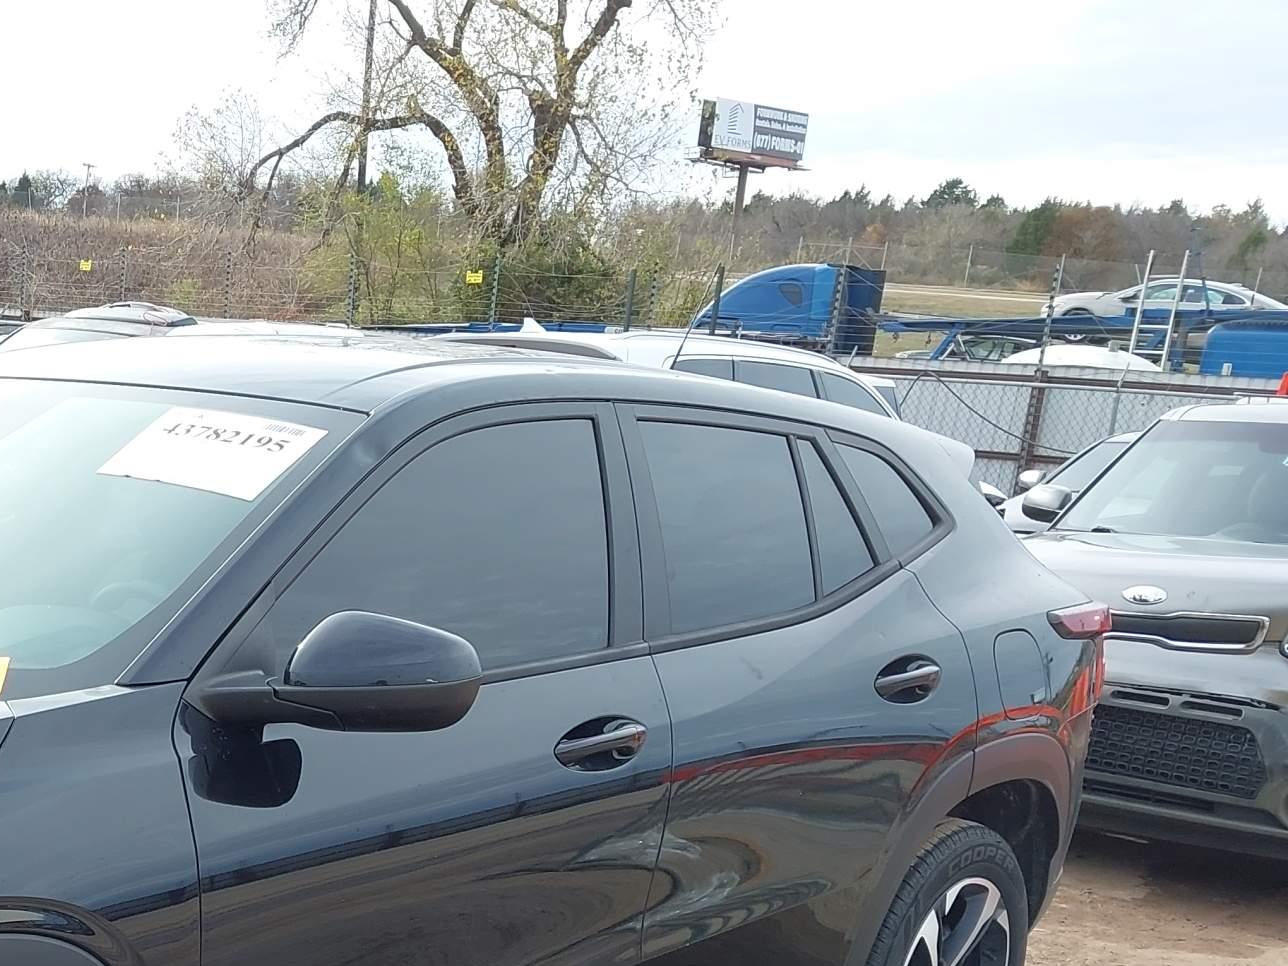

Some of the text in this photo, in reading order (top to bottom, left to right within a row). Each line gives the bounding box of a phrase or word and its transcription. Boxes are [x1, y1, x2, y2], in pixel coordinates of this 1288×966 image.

[727, 137, 752, 150] FORMS
[163, 423, 291, 453] 43782195
[948, 846, 1016, 876] COOPER
